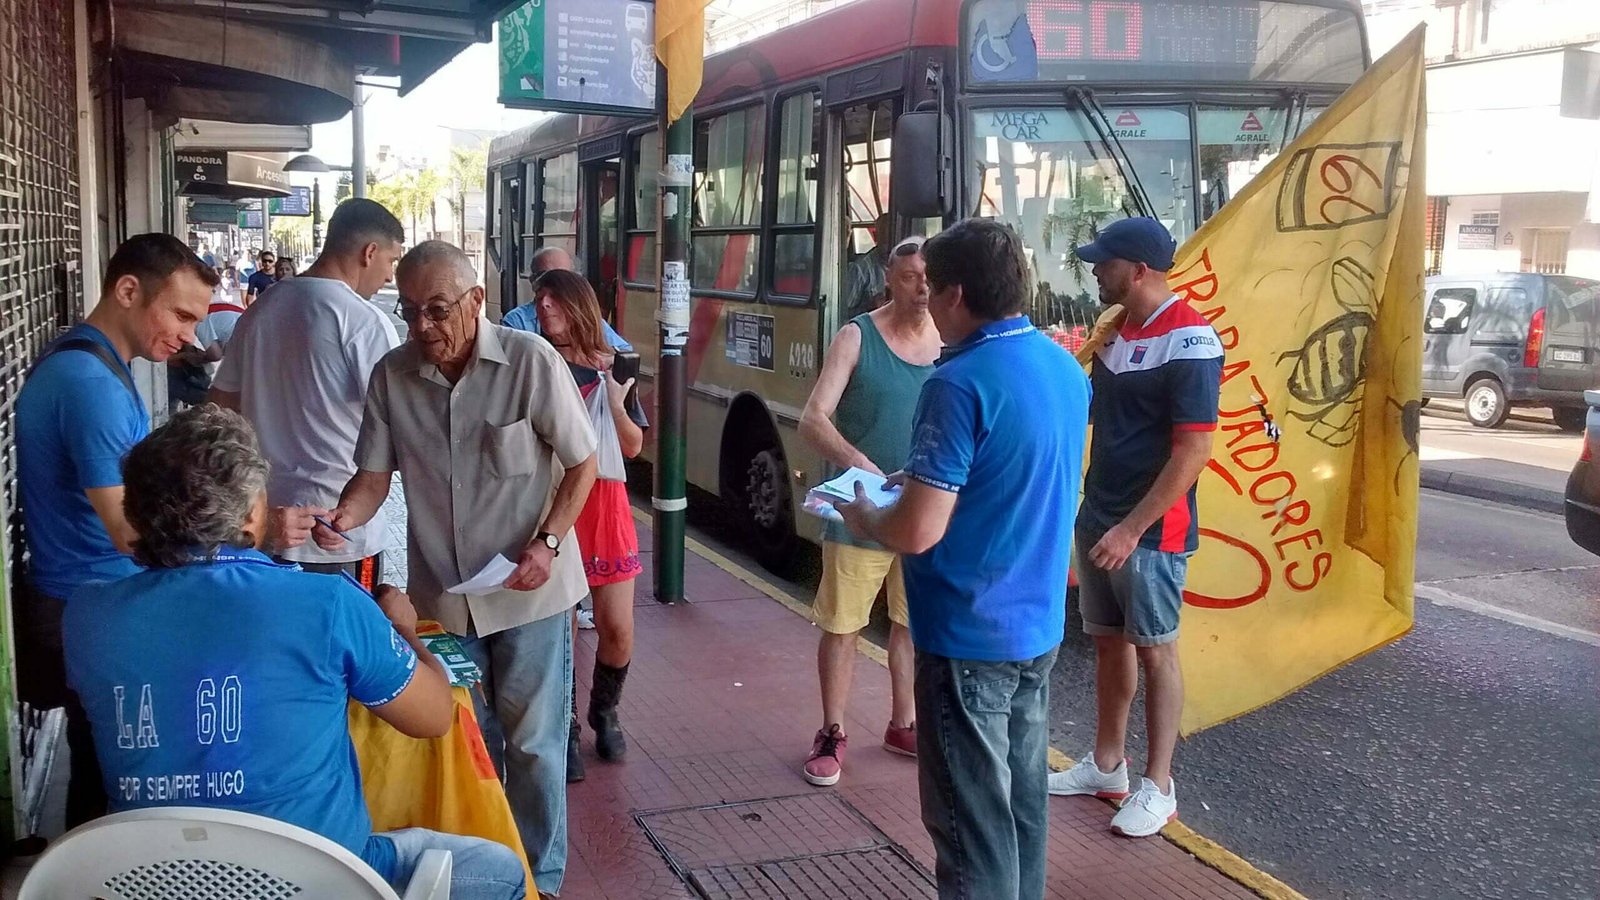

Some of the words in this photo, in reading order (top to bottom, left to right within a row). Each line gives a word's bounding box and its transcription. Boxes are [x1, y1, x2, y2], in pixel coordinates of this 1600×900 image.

[1026, 0, 1143, 60] 60
[991, 111, 1048, 127] MEGA
[1002, 124, 1042, 140] CAR
[1106, 129, 1147, 138] AGRALE
[1235, 133, 1269, 142] AGRALE
[177, 155, 223, 165] PANDORA
[193, 173, 207, 181] Co
[196, 165, 204, 173] &
[760, 334, 772, 359] 60
[113, 684, 159, 748] LA
[197, 675, 241, 744] 60
[119, 777, 141, 801] POR
[147, 774, 201, 801] SIEMPRE
[207, 770, 244, 798] HUGO
